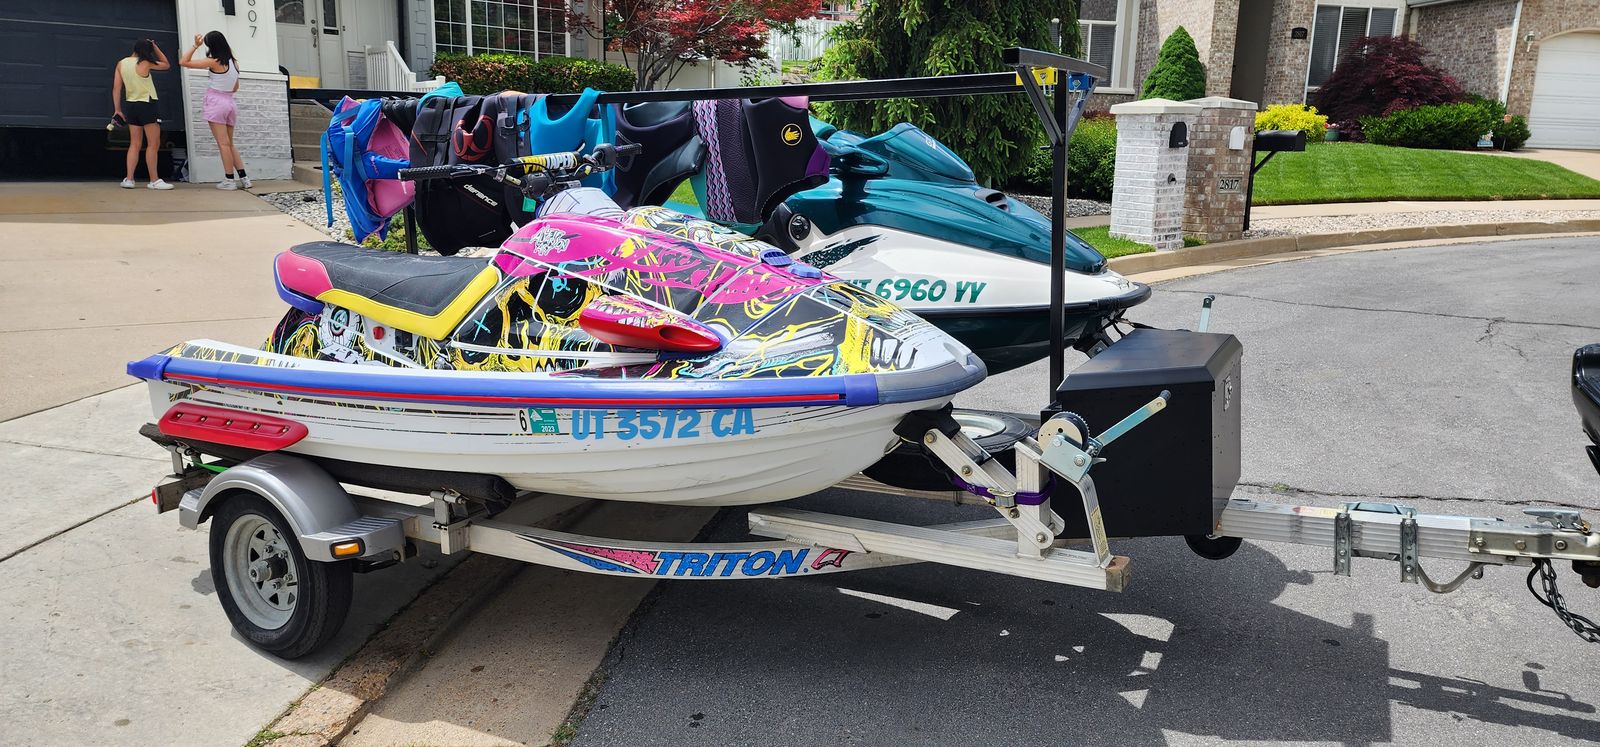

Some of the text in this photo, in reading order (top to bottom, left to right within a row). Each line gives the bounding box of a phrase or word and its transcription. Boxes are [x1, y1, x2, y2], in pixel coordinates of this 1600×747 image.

[463, 184, 498, 207] defiance
[1219, 179, 1239, 190] 2817
[875, 278, 947, 302] 6960
[954, 280, 987, 304] YY
[519, 409, 528, 432] 6
[541, 425, 555, 433] 2023
[572, 409, 608, 441] UT
[616, 409, 702, 440] 3572
[711, 408, 755, 438] CA
